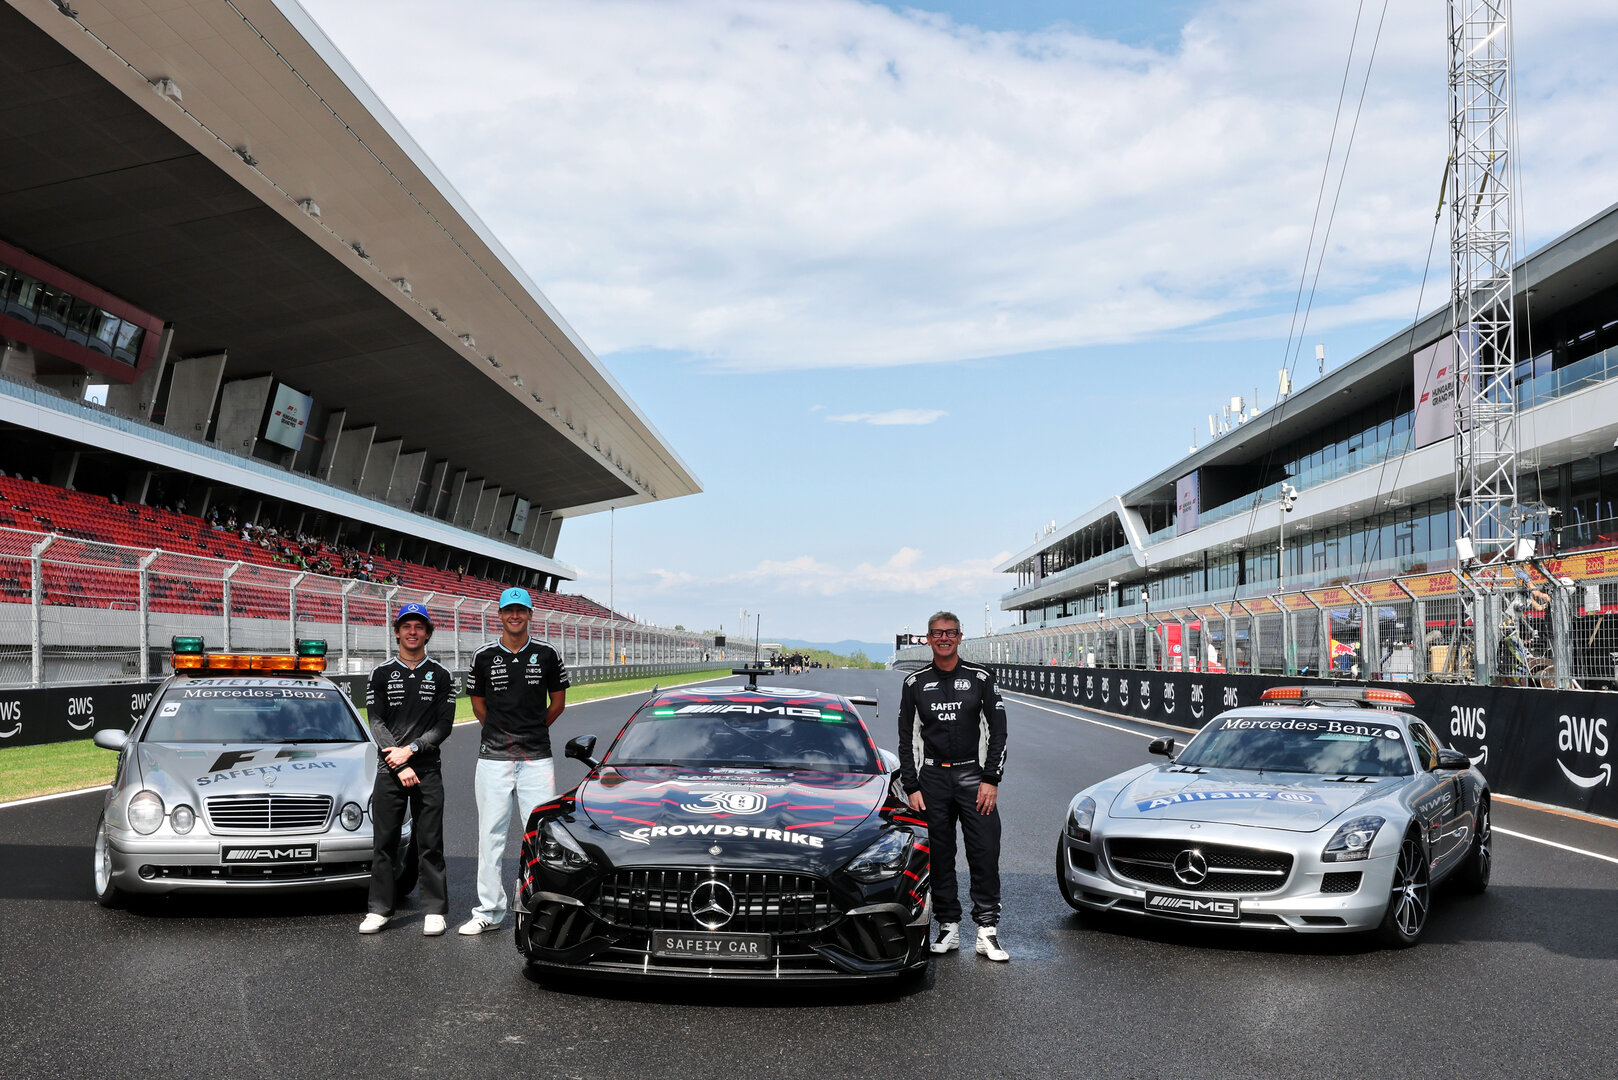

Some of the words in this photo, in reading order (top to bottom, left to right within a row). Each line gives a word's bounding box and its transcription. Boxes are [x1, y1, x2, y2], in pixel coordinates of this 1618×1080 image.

[186, 679, 270, 687] SAFETY
[278, 679, 319, 687] CAR
[955, 680, 969, 688] FIA
[1164, 682, 1175, 700] aws
[182, 689, 326, 699] Mercedes-Benz
[1191, 684, 1204, 703] aws
[1223, 686, 1238, 707] aws
[0, 701, 21, 721] ws
[68, 696, 94, 716] aws
[722, 704, 821, 718] AMG
[930, 701, 962, 711] SAFETY
[937, 712, 957, 721] CAR
[1450, 705, 1487, 740] aws
[1219, 718, 1383, 738] Mercedes-Benz
[1558, 714, 1609, 757] aws
[197, 764, 282, 786] SAFETY
[292, 761, 337, 770] CAR
[680, 790, 767, 814] 30
[1149, 790, 1272, 809] Allianz
[634, 824, 824, 848] CROWDSTRIKE
[253, 848, 312, 859] AMG
[1178, 899, 1234, 913] AMG
[666, 937, 723, 951] SAFETY
[728, 941, 758, 953] CAR
